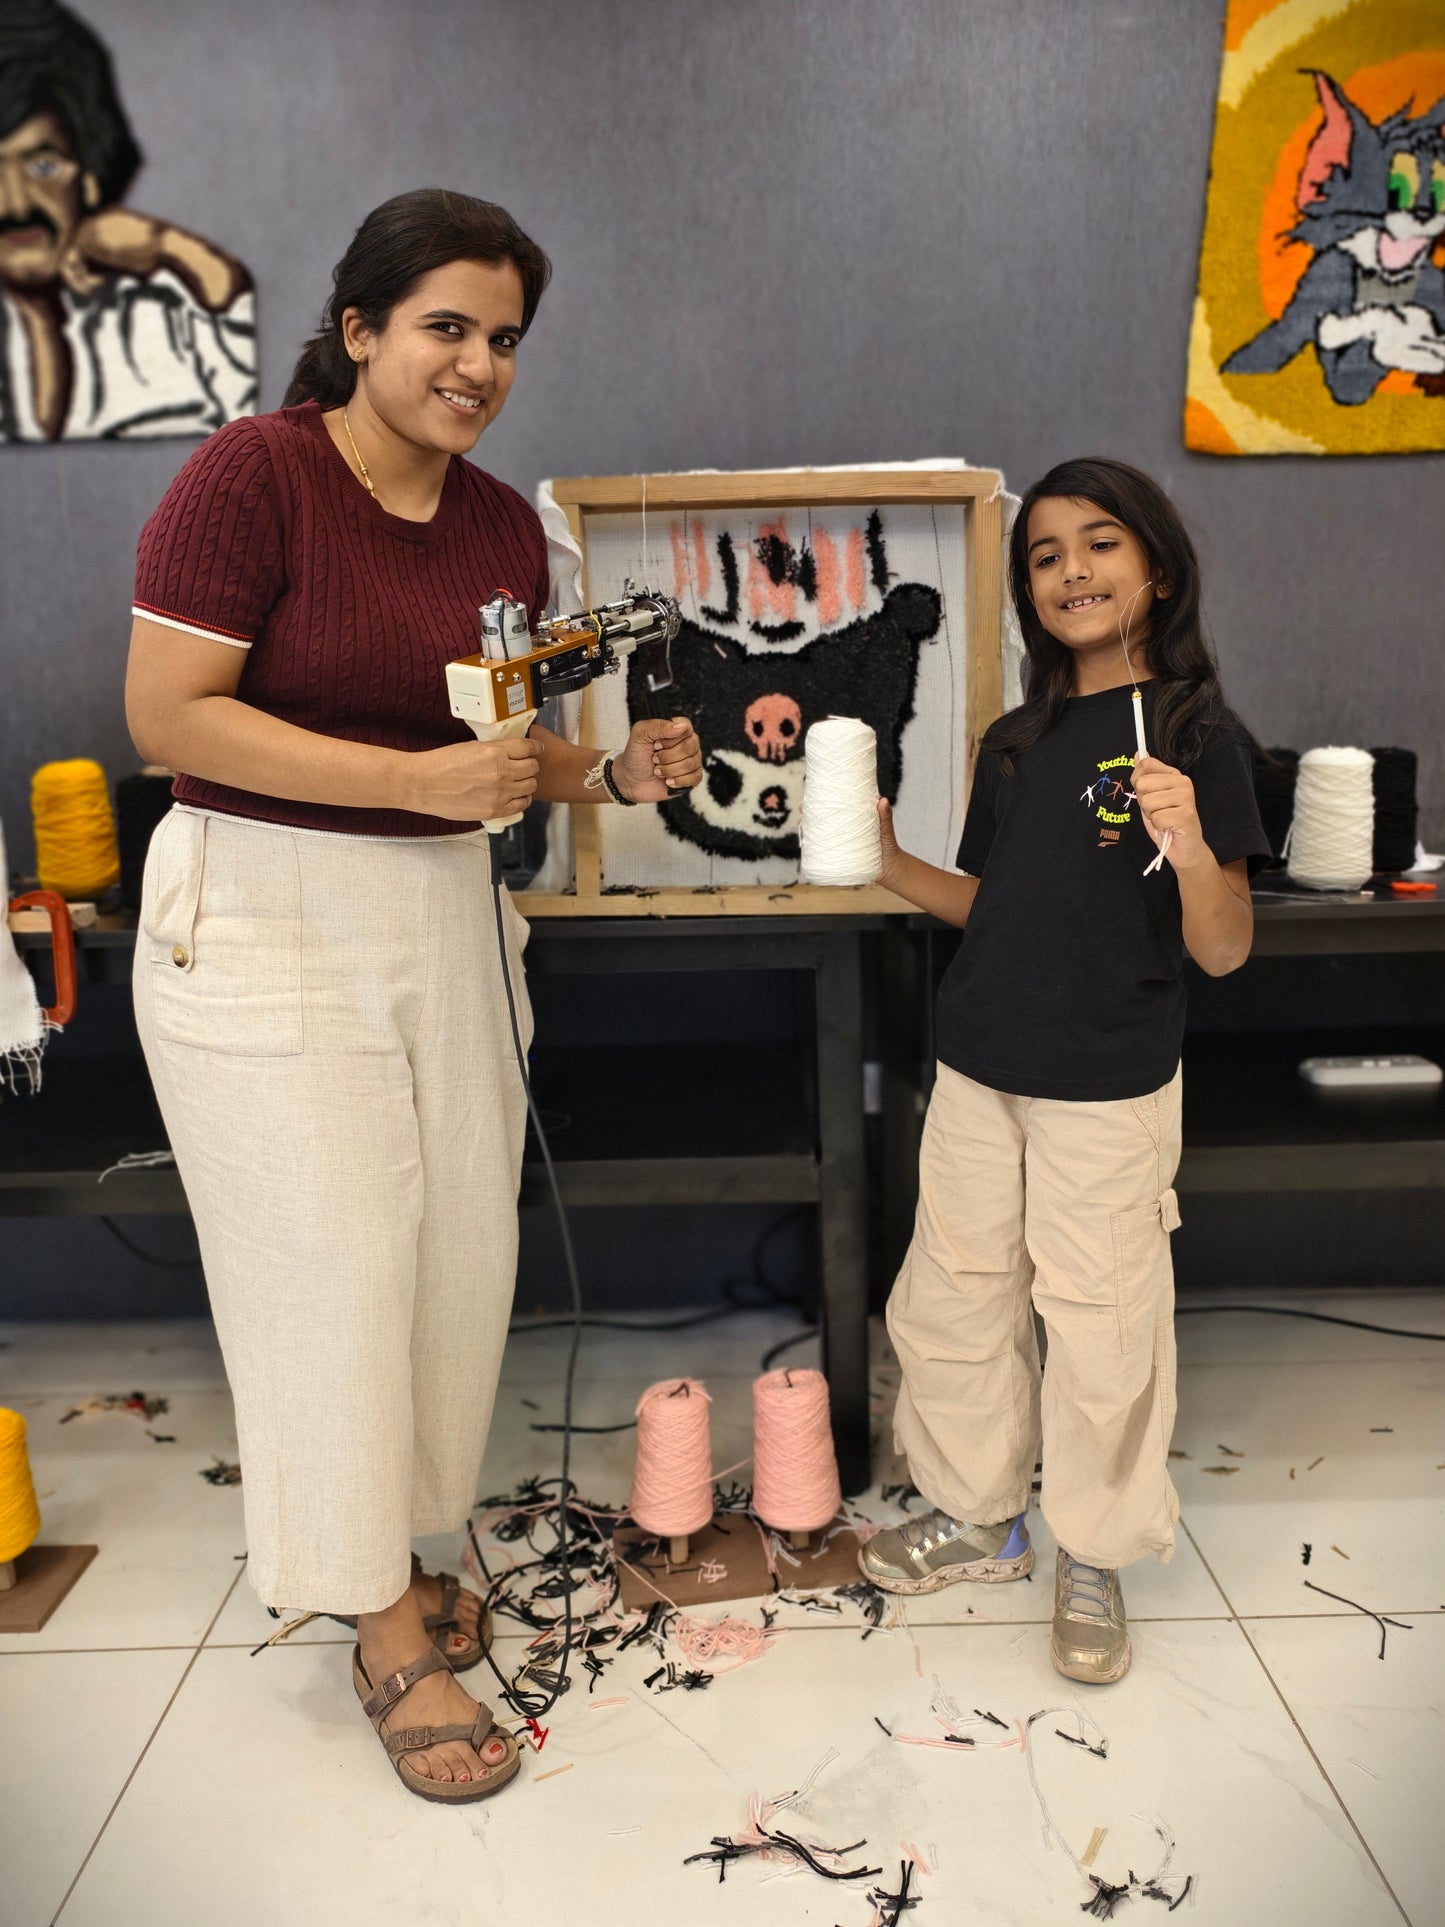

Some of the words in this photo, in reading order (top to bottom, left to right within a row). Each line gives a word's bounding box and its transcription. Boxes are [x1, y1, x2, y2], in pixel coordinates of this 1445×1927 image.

[1097, 755, 1128, 772] Youth
[1128, 758, 1136, 768] a
[1096, 805, 1131, 824] Future
[1100, 828, 1121, 841] PUMA
